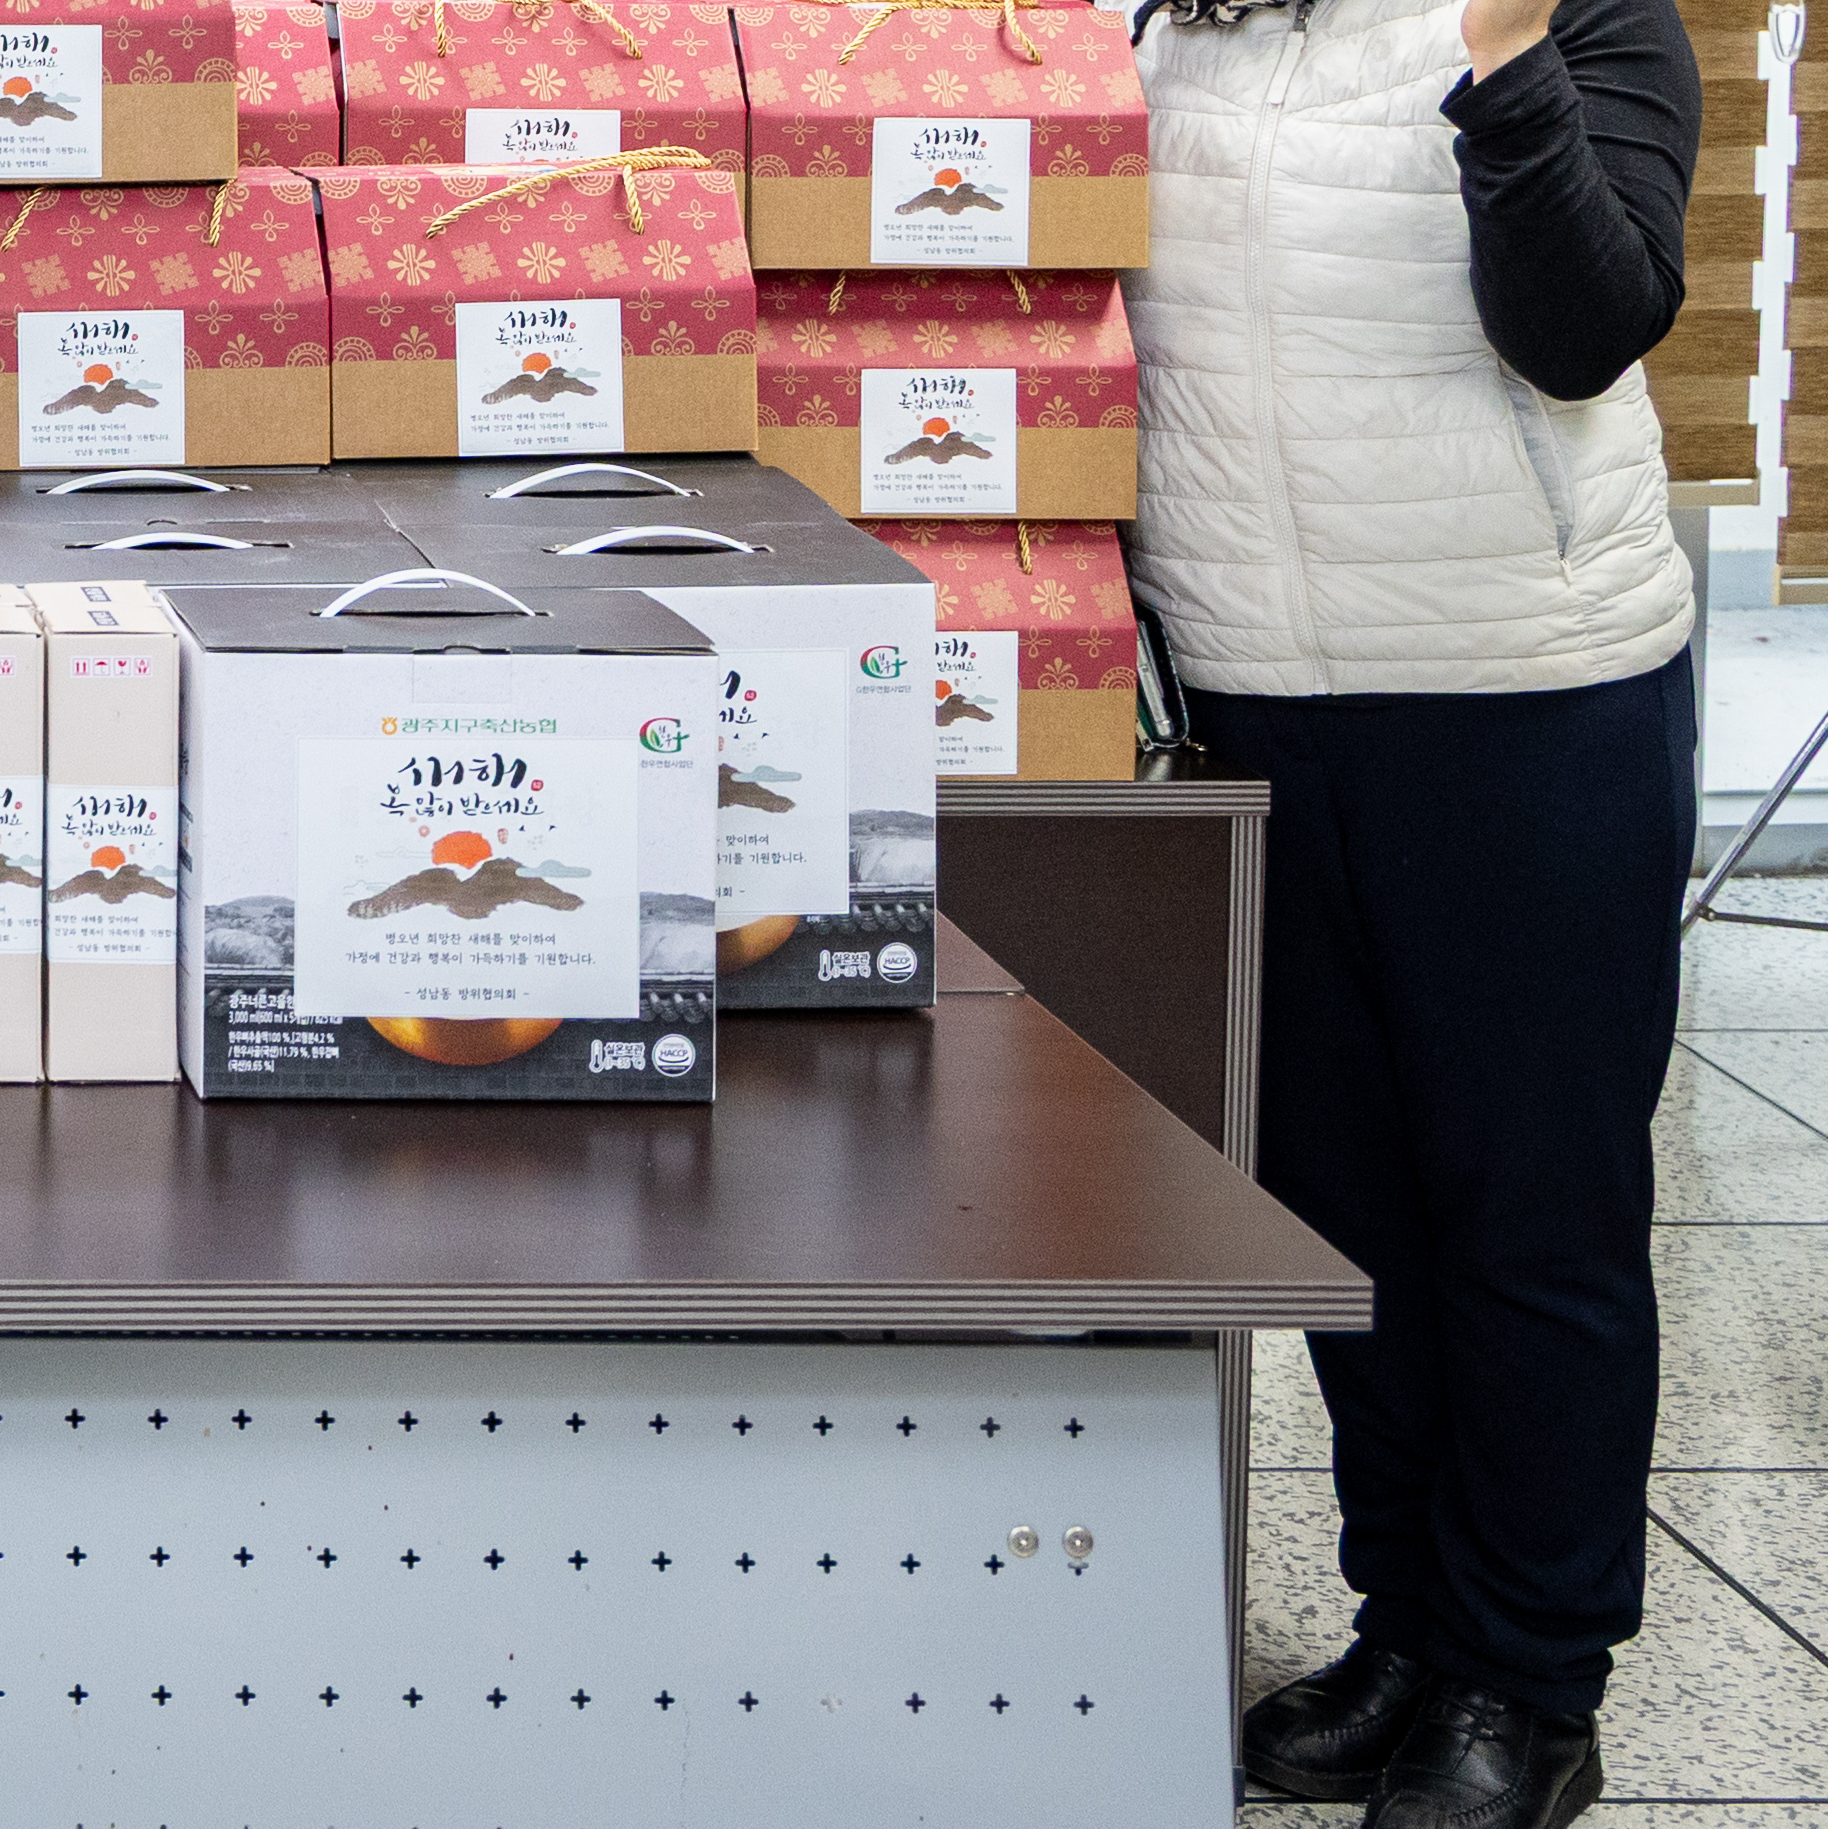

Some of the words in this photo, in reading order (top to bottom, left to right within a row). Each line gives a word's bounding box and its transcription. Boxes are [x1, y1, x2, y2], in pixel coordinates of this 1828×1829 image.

[511, 118, 571, 137] 새해
[920, 127, 979, 146] 새해
[505, 308, 567, 328] 새해
[67, 319, 129, 339] 새해
[402, 718, 557, 733] 광주지구축산농협
[398, 753, 527, 788] 새해
[72, 793, 147, 817] 새해
[380, 784, 410, 816] 복
[416, 791, 453, 817] 많이
[460, 793, 544, 815] 받으세요
[726, 834, 769, 846] 맞이하여
[750, 852, 806, 864] 기원합니다.
[385, 933, 419, 945] 병오년
[427, 933, 461, 945] 희망찬
[468, 933, 502, 945] 새해를
[509, 933, 555, 945] 맞이하여
[345, 952, 380, 963] 가정에
[388, 952, 421, 964] 건강과
[429, 952, 462, 964] 행복이
[470, 952, 527, 965] 가득하기를
[417, 988, 451, 1000] 성남동
[459, 988, 516, 1000] 방위협의회
